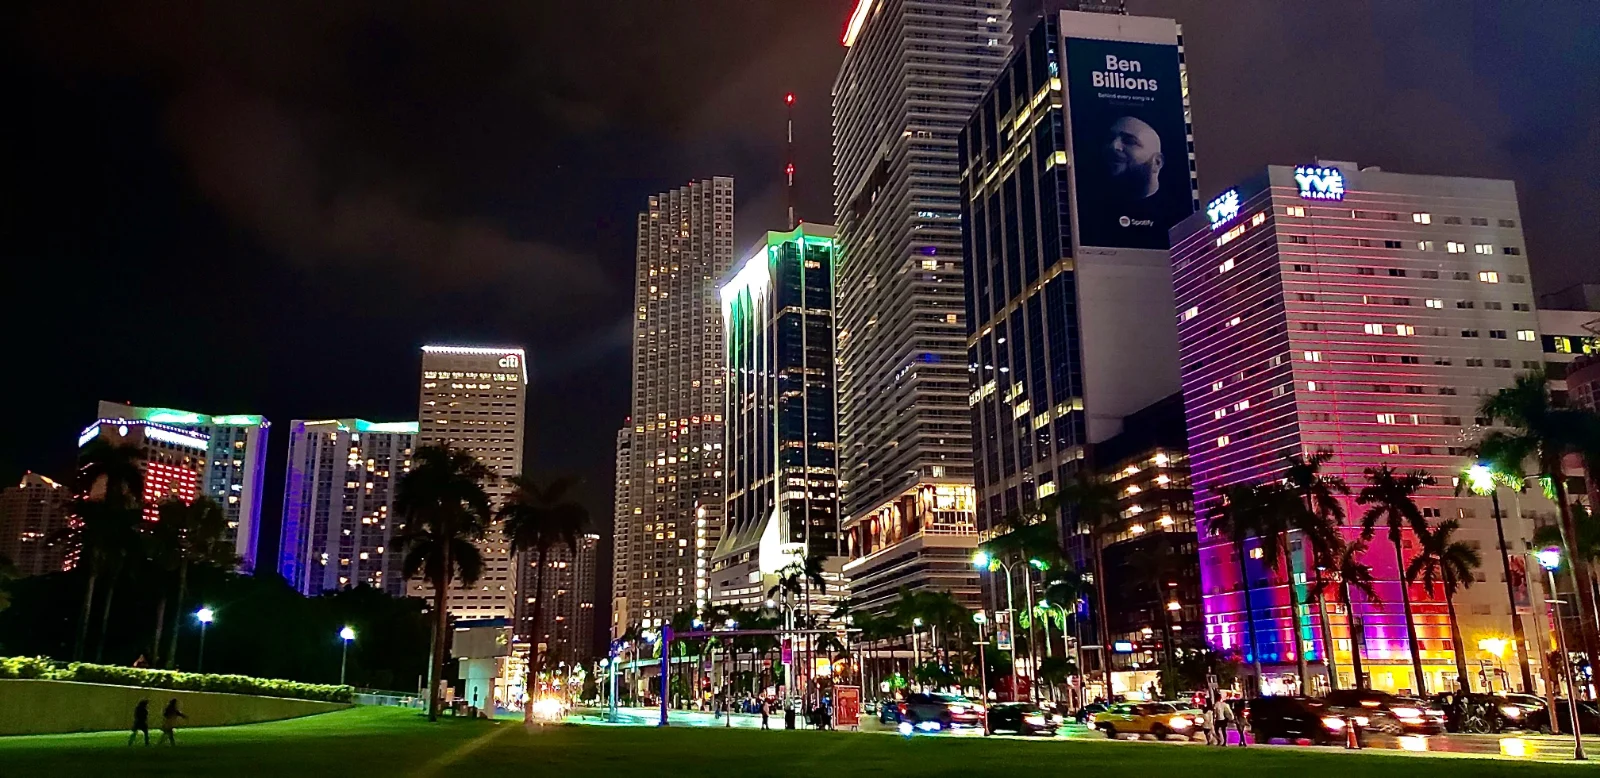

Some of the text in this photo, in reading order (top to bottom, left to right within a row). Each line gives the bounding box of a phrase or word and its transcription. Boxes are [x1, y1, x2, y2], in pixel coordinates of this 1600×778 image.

[1106, 55, 1141, 72] Ben
[1092, 71, 1157, 91] Billions
[1296, 167, 1338, 176] HOTEL
[1295, 174, 1343, 194] YVE
[1301, 190, 1341, 200] MIAMI
[1207, 195, 1240, 222] YVE
[1131, 218, 1154, 227] Spotify
[499, 355, 518, 368] citi
